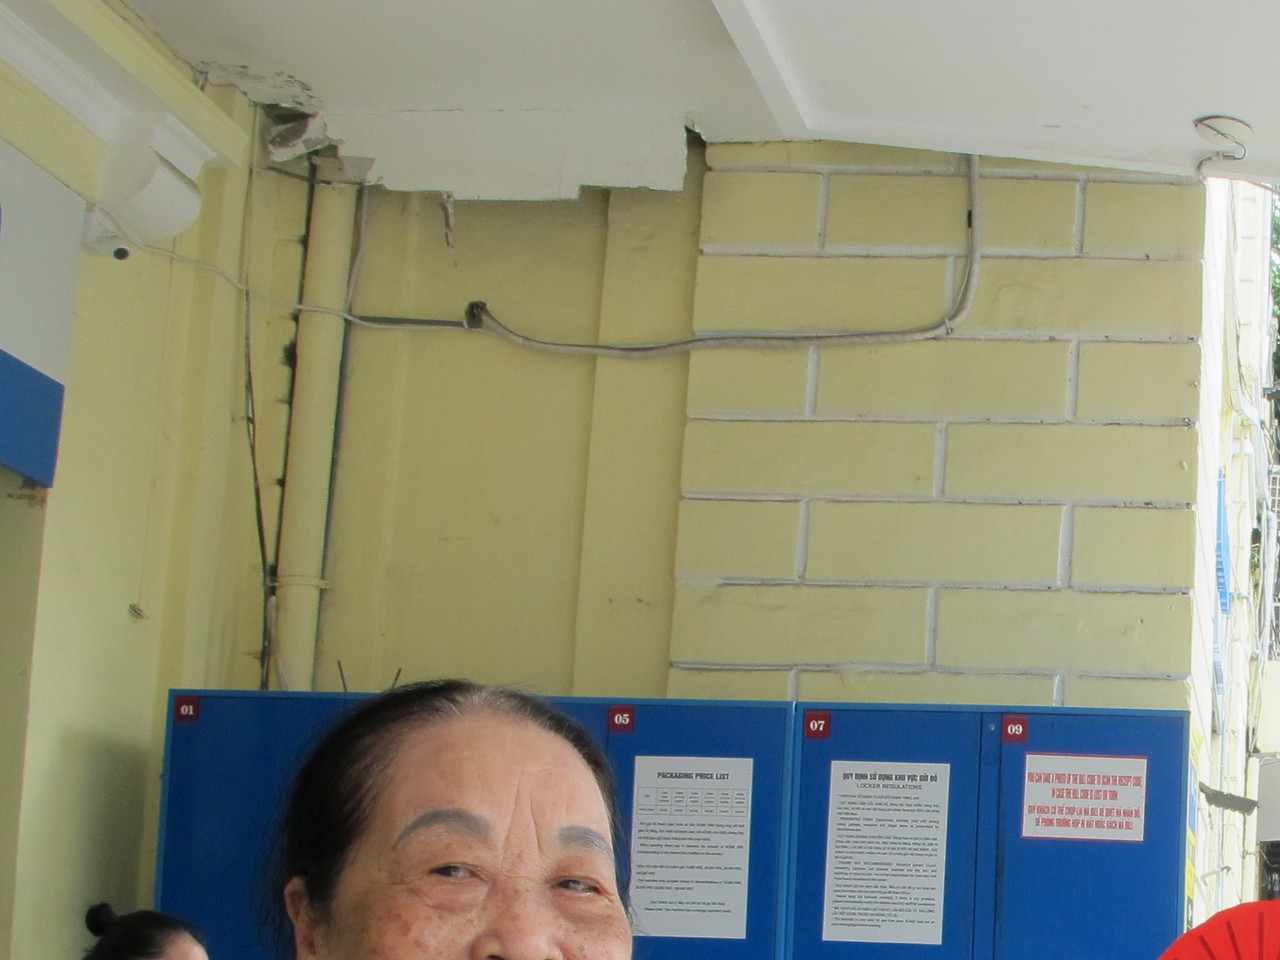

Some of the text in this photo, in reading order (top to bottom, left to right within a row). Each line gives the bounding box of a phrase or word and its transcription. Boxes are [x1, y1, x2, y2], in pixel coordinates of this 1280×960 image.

[180, 705, 194, 715] 01
[614, 713, 630, 725] 05
[809, 720, 826, 731] 07
[1007, 724, 1023, 735] 09
[657, 772, 693, 780] PACKAGING
